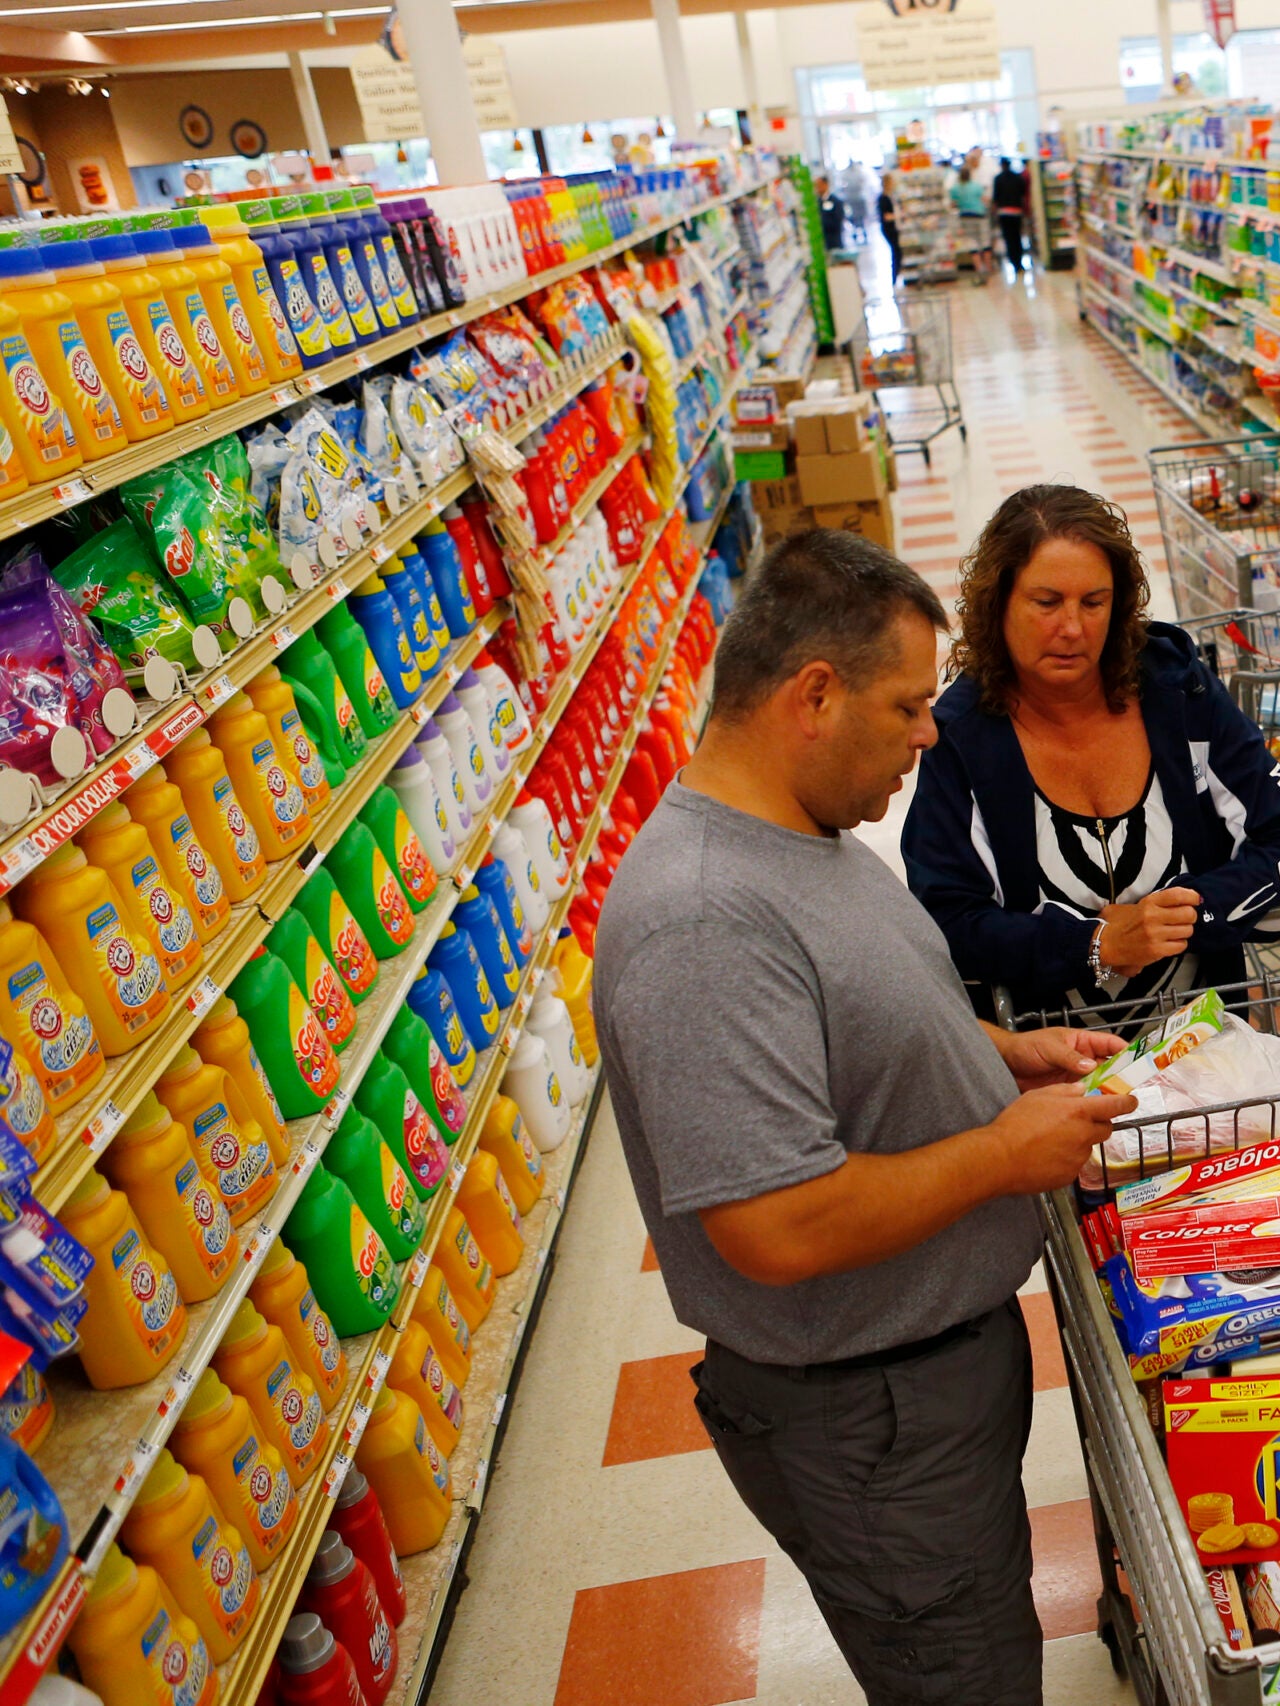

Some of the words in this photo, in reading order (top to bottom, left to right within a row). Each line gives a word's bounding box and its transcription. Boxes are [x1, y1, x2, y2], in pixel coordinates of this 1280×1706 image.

[51, 800, 84, 839] YOUR
[1139, 1221, 1252, 1242] Colgate
[1171, 1321, 1207, 1342] FAMILY
[1173, 1328, 1210, 1349] SIZE!
[1220, 1381, 1270, 1393] FAMILY
[1229, 1388, 1264, 1398] SIZE!
